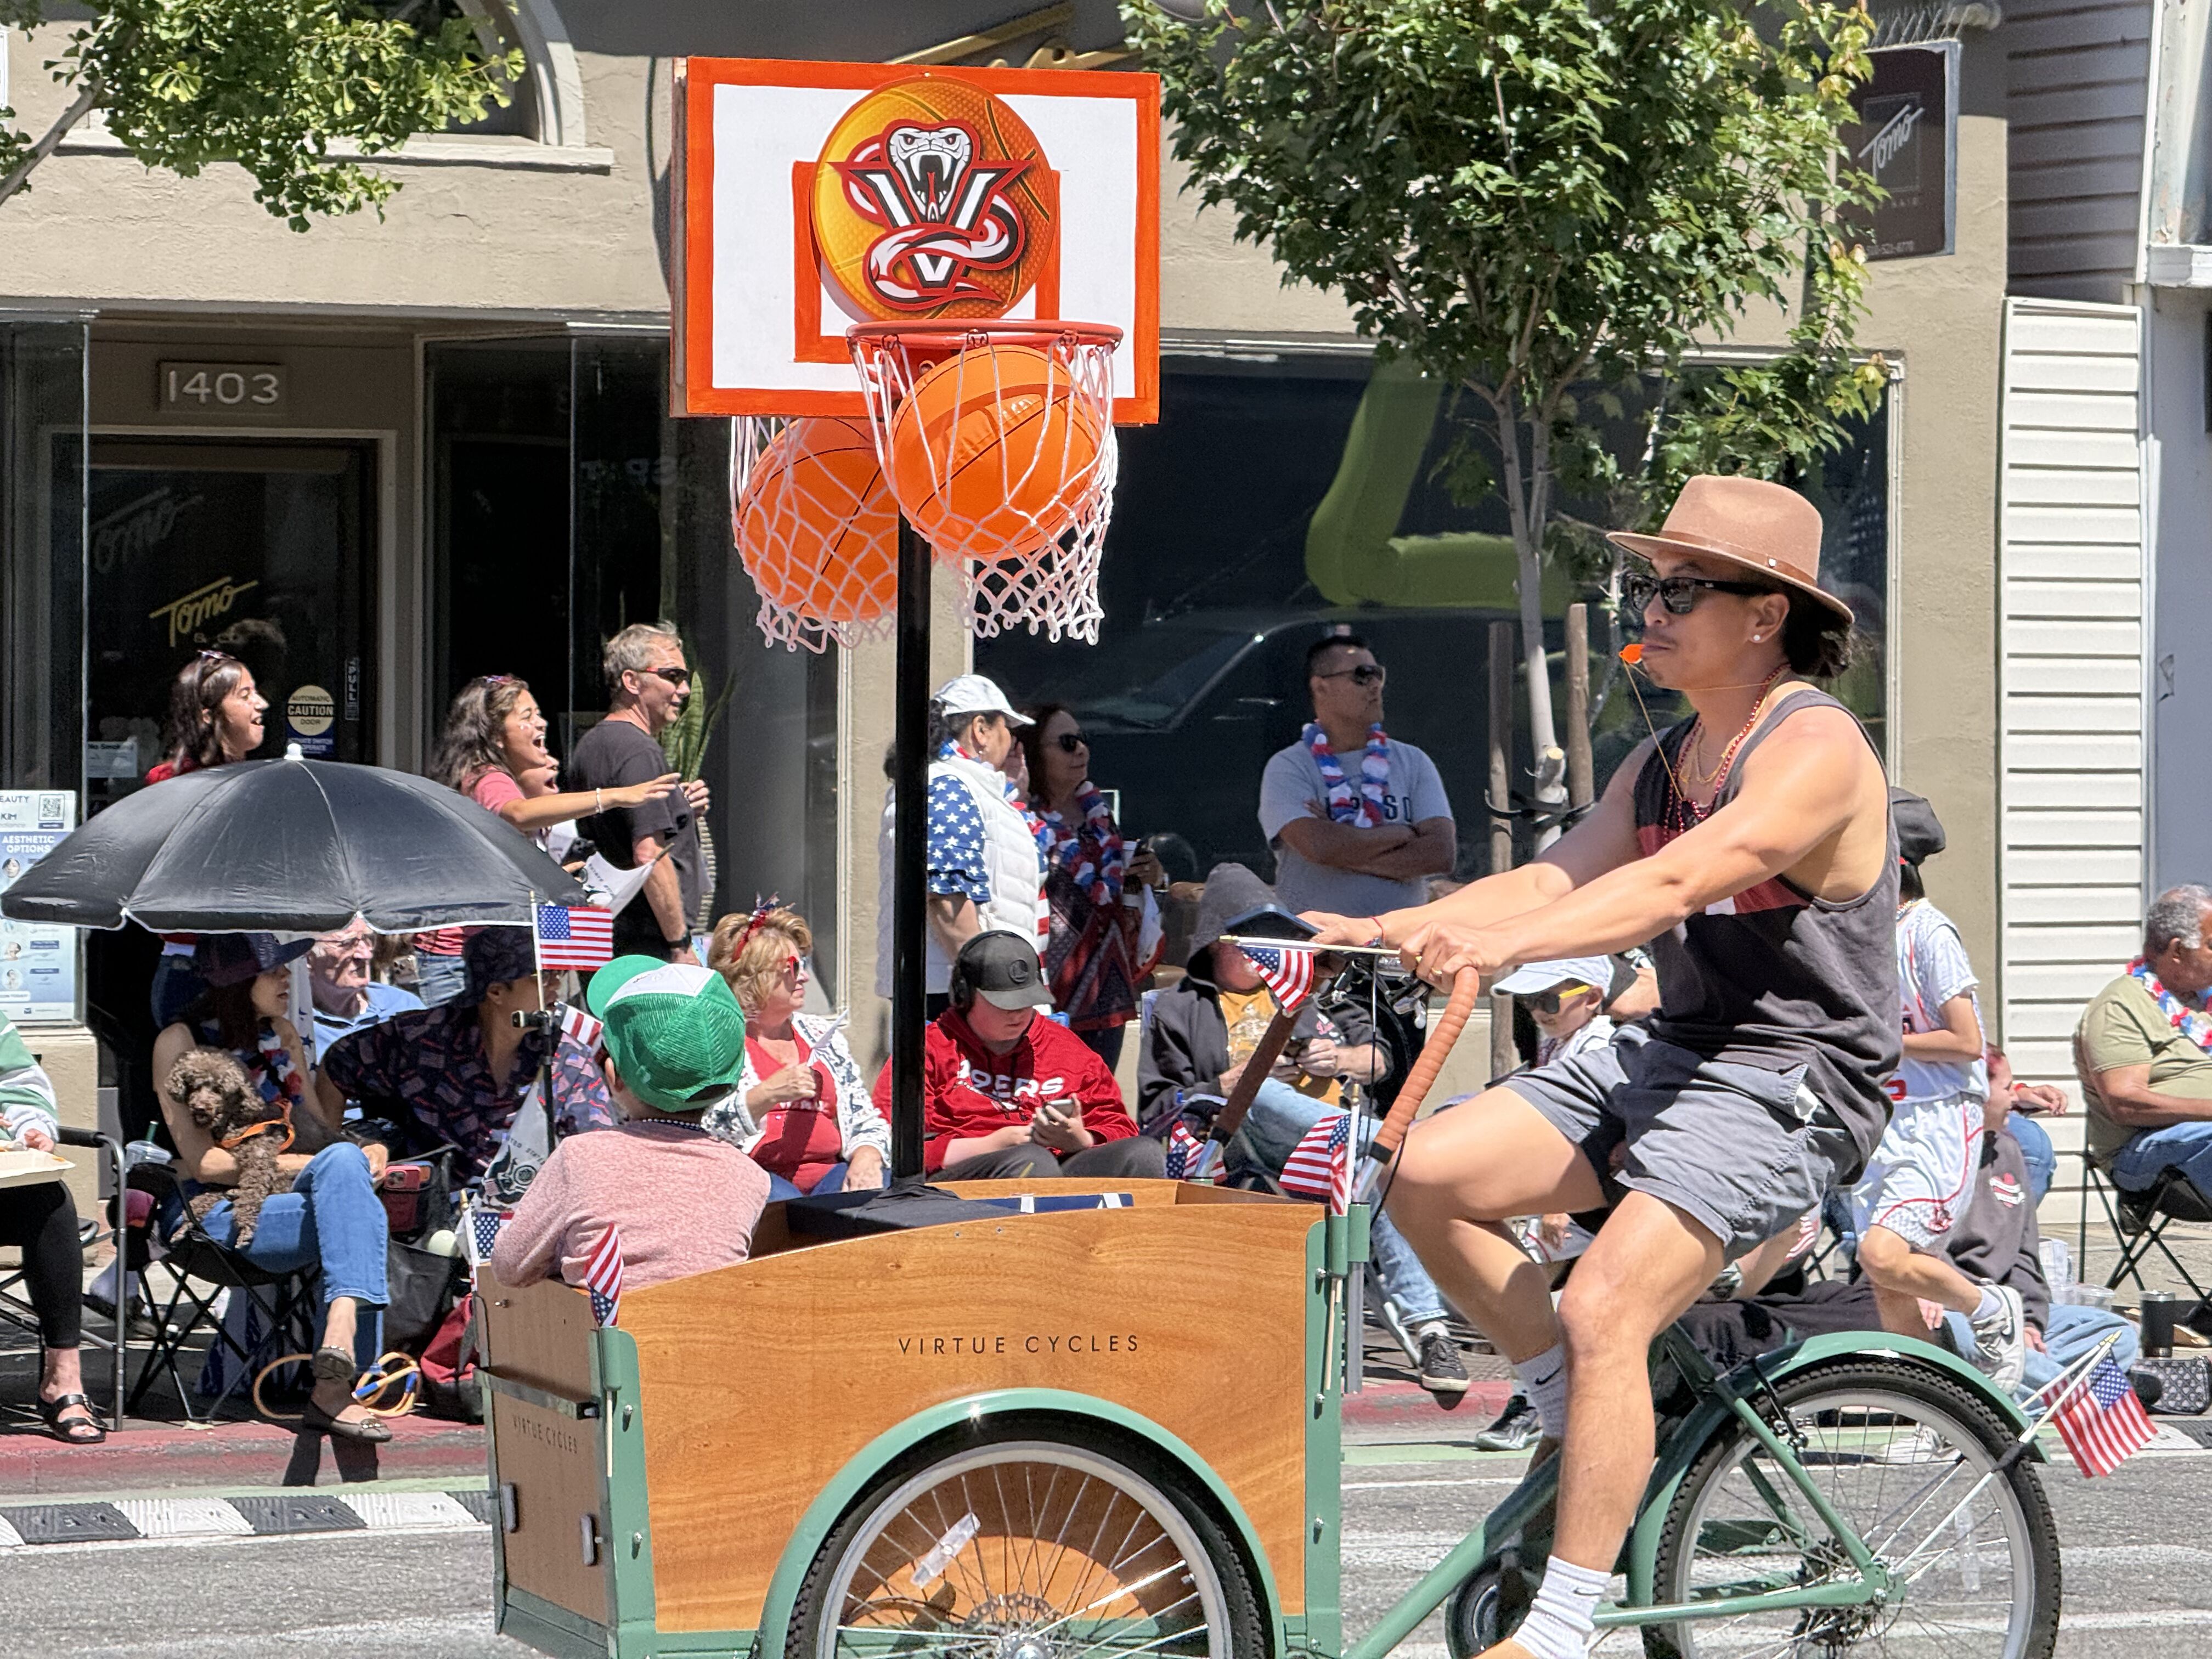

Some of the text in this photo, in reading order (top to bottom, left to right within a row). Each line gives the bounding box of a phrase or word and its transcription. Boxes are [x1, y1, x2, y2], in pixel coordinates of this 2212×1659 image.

[1858, 104, 1925, 179] Tomo
[167, 370, 279, 405] 1403
[149, 575, 258, 647] Tomo
[287, 706, 334, 716] CAUTION
[2, 836, 55, 844] AESTHETIC
[7, 844, 51, 853] OPTIONS
[899, 1335, 1138, 1354] VIRTUE CYCLES
[512, 1415, 577, 1454] VIRTUE CYCLES
